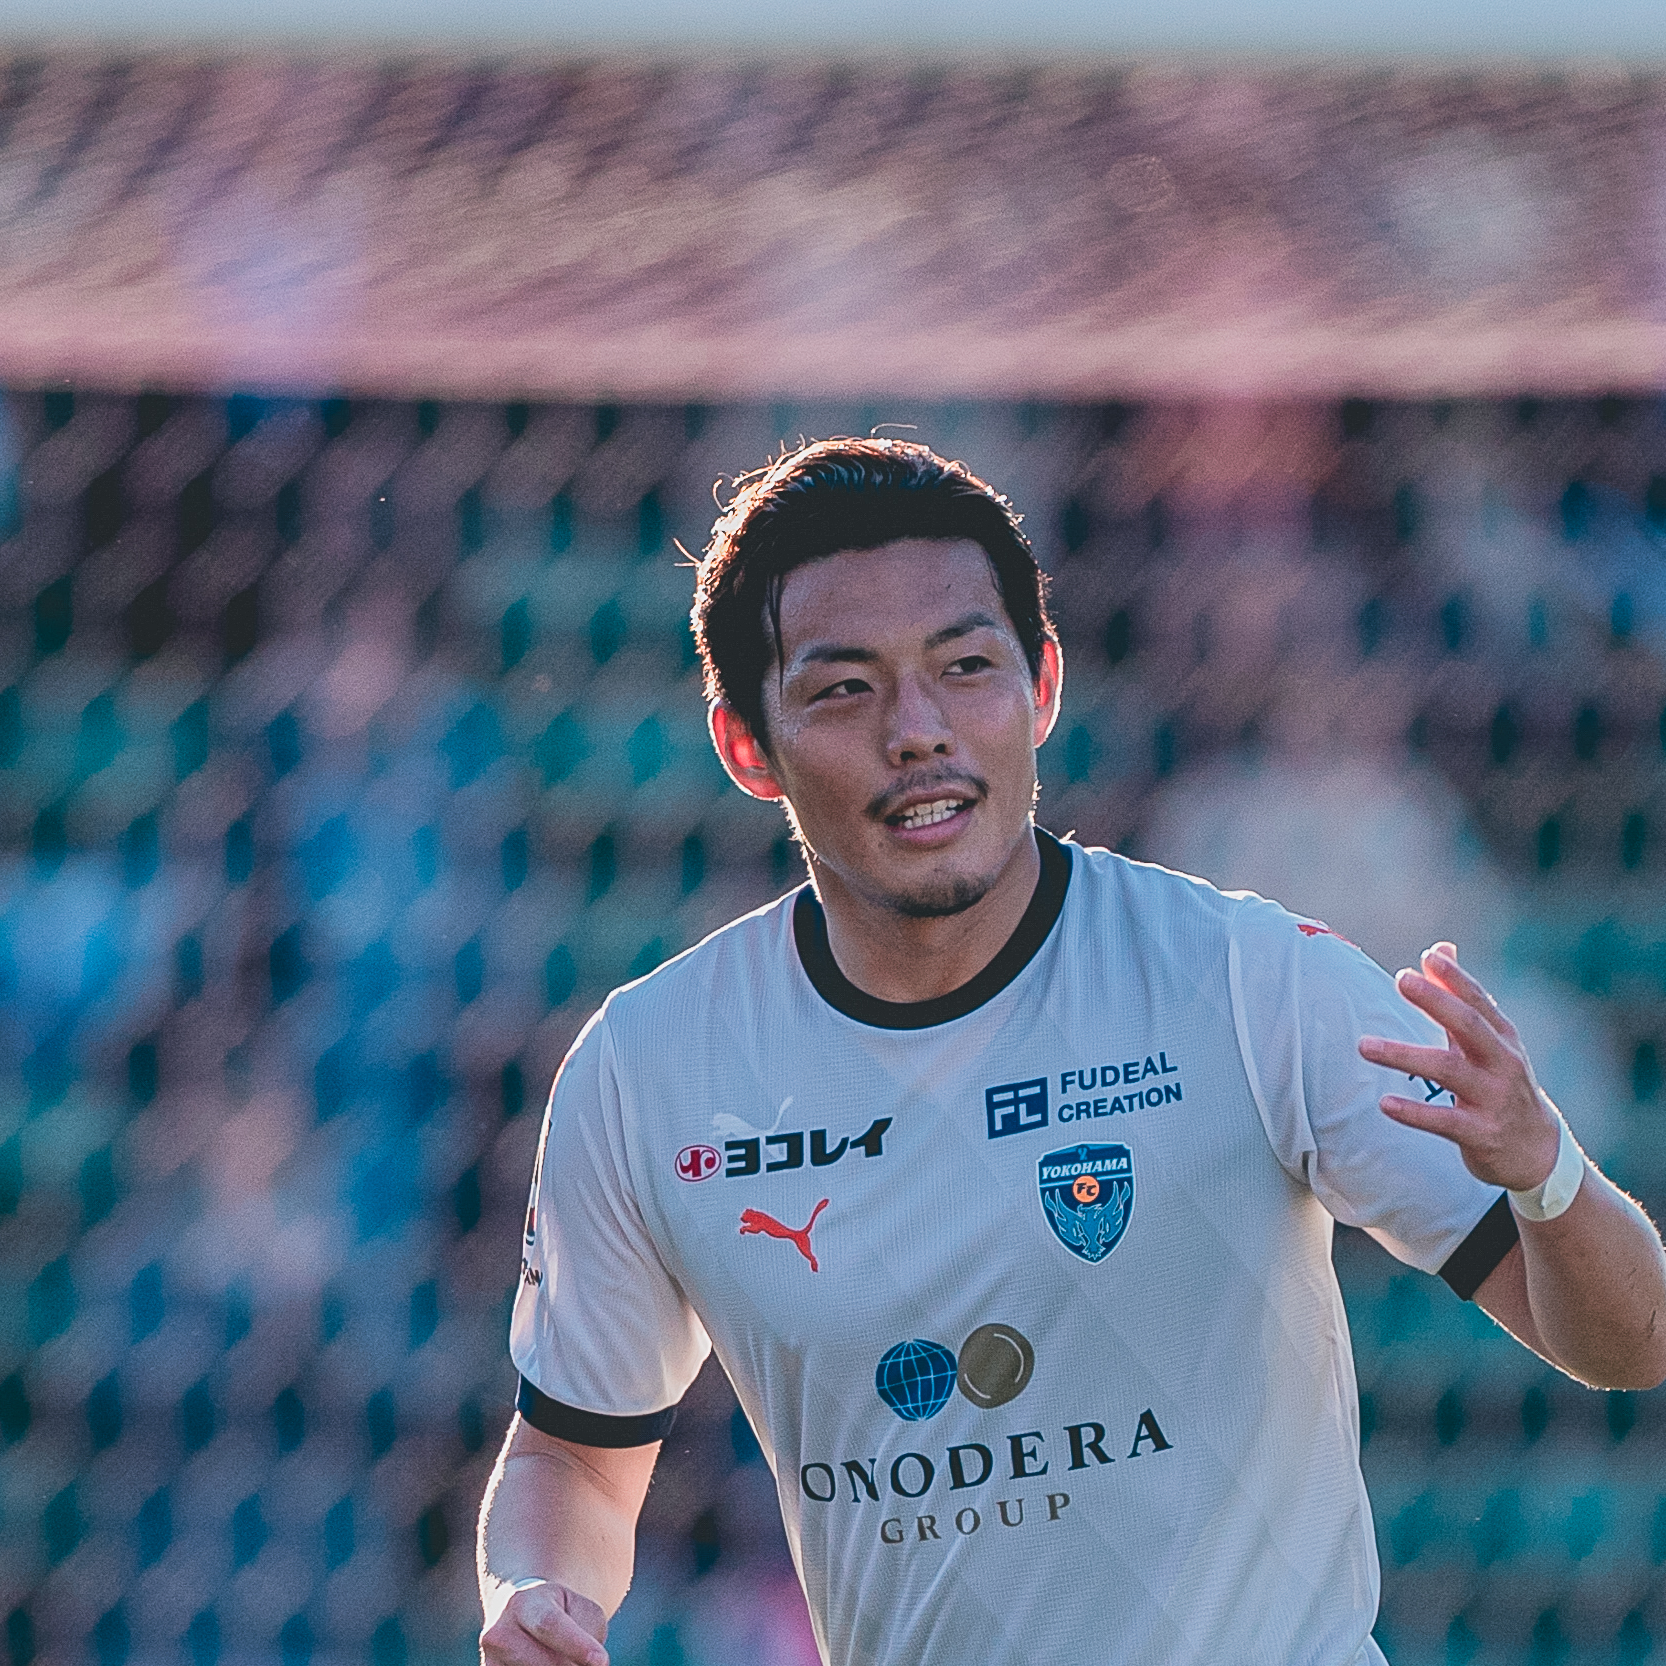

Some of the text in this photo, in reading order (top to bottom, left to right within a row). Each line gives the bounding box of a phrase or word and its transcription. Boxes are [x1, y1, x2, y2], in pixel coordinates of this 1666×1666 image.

[1060, 1051, 1178, 1095] FUDEAL
[1057, 1082, 1184, 1124] CREATION
[724, 1116, 894, 1179] ヨコレイ
[1041, 1157, 1129, 1180] YOKOHAMA
[1075, 1182, 1097, 1197] FC
[800, 1407, 1174, 1504] ONODERA
[879, 1492, 1071, 1545] GROUP
